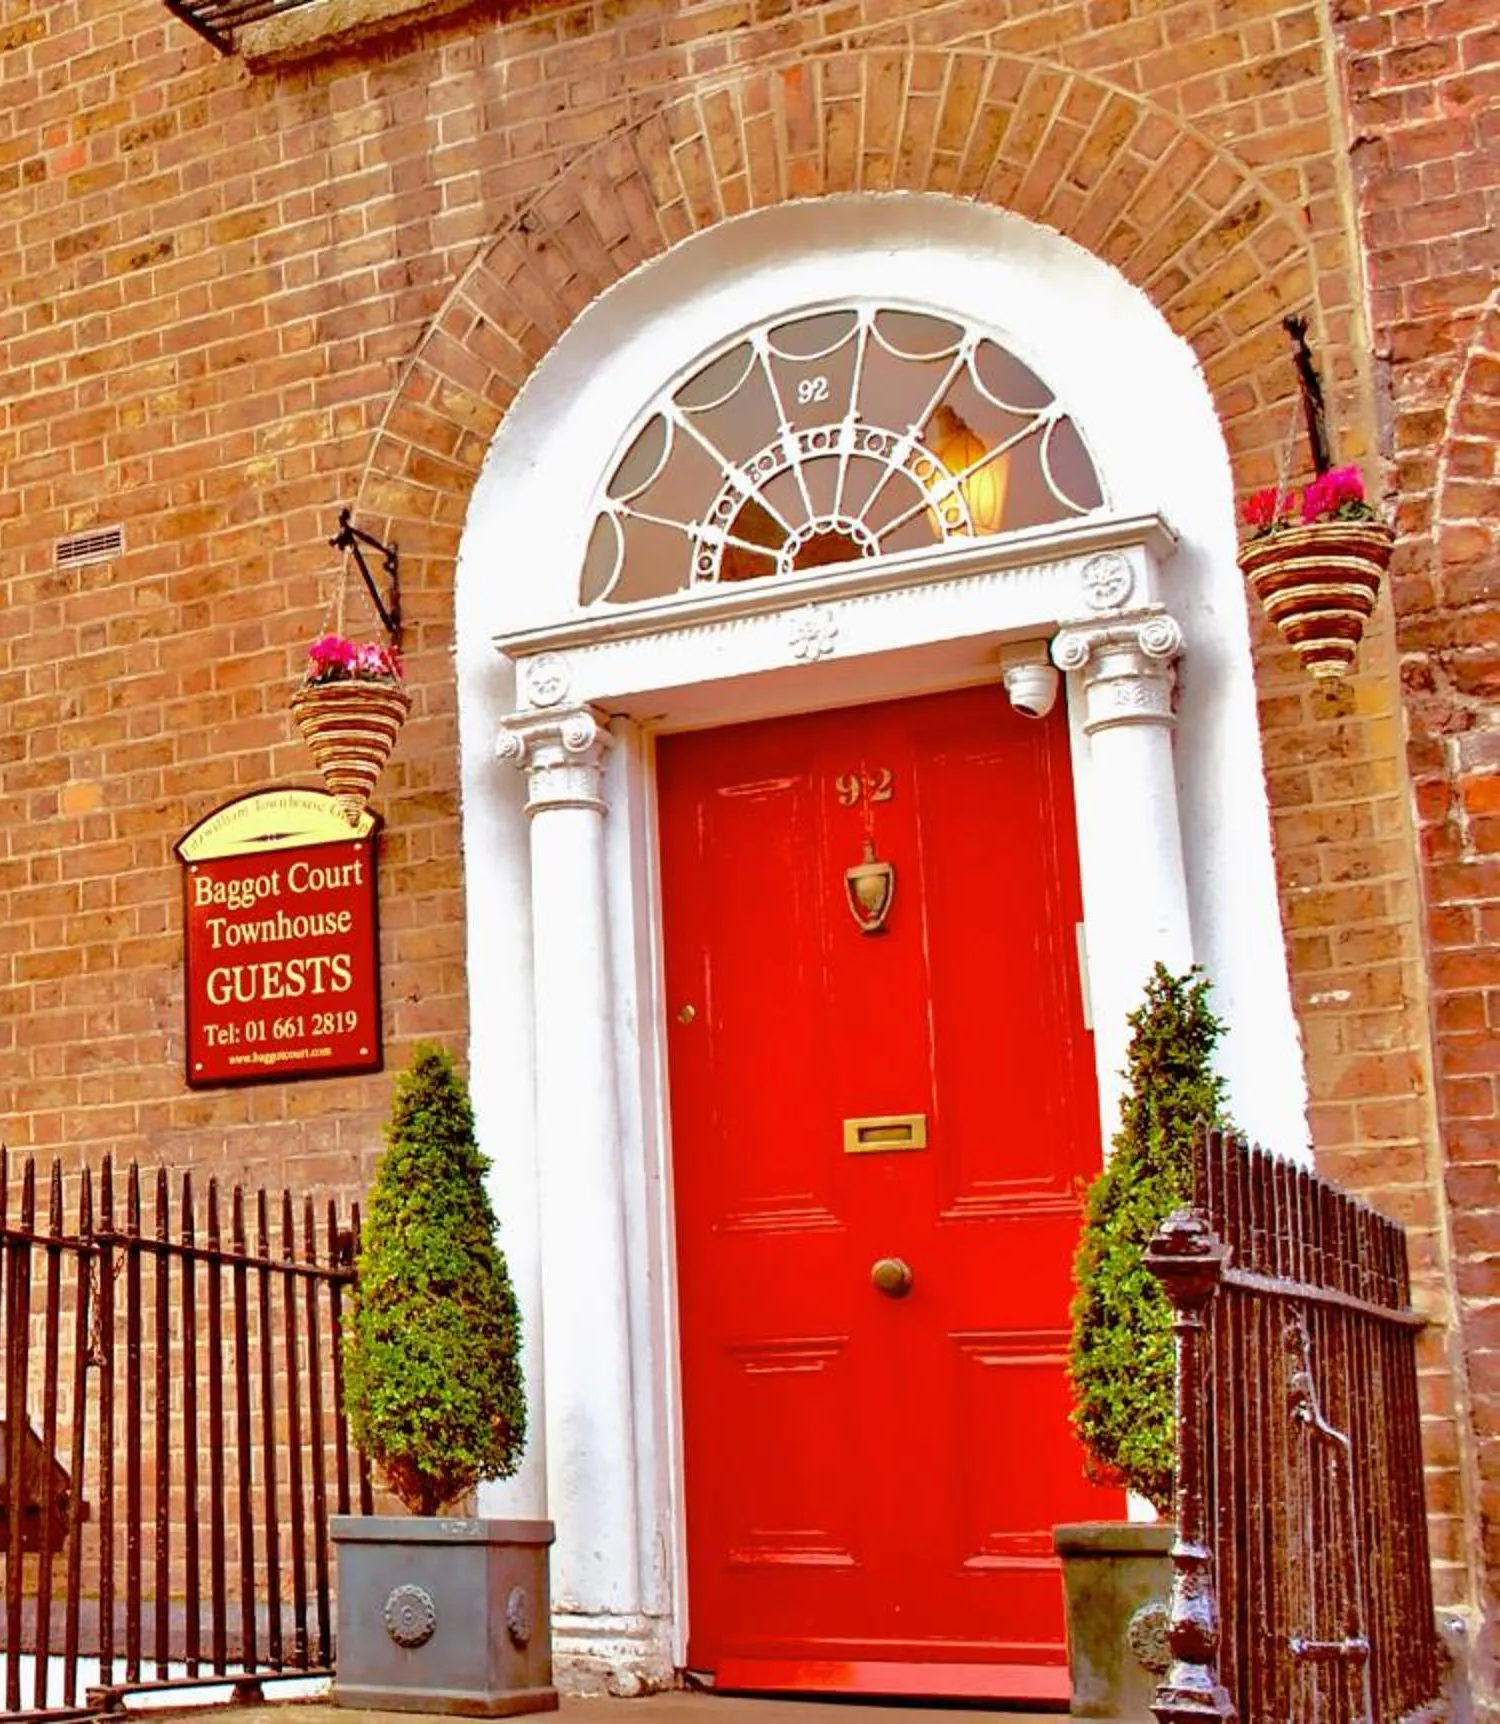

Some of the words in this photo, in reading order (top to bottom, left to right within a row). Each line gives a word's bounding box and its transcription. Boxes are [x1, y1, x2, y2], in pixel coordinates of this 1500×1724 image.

[798, 376, 829, 404] 92
[835, 767, 893, 807] 92
[194, 869, 281, 911] Baggot
[287, 859, 363, 894] Court
[205, 909, 353, 949] Townhouse
[206, 953, 353, 1006] GUESTS
[203, 1022, 241, 1047] Tel:
[244, 1019, 268, 1043] 01
[272, 1015, 306, 1040] 661
[311, 1010, 358, 1037] 2819
